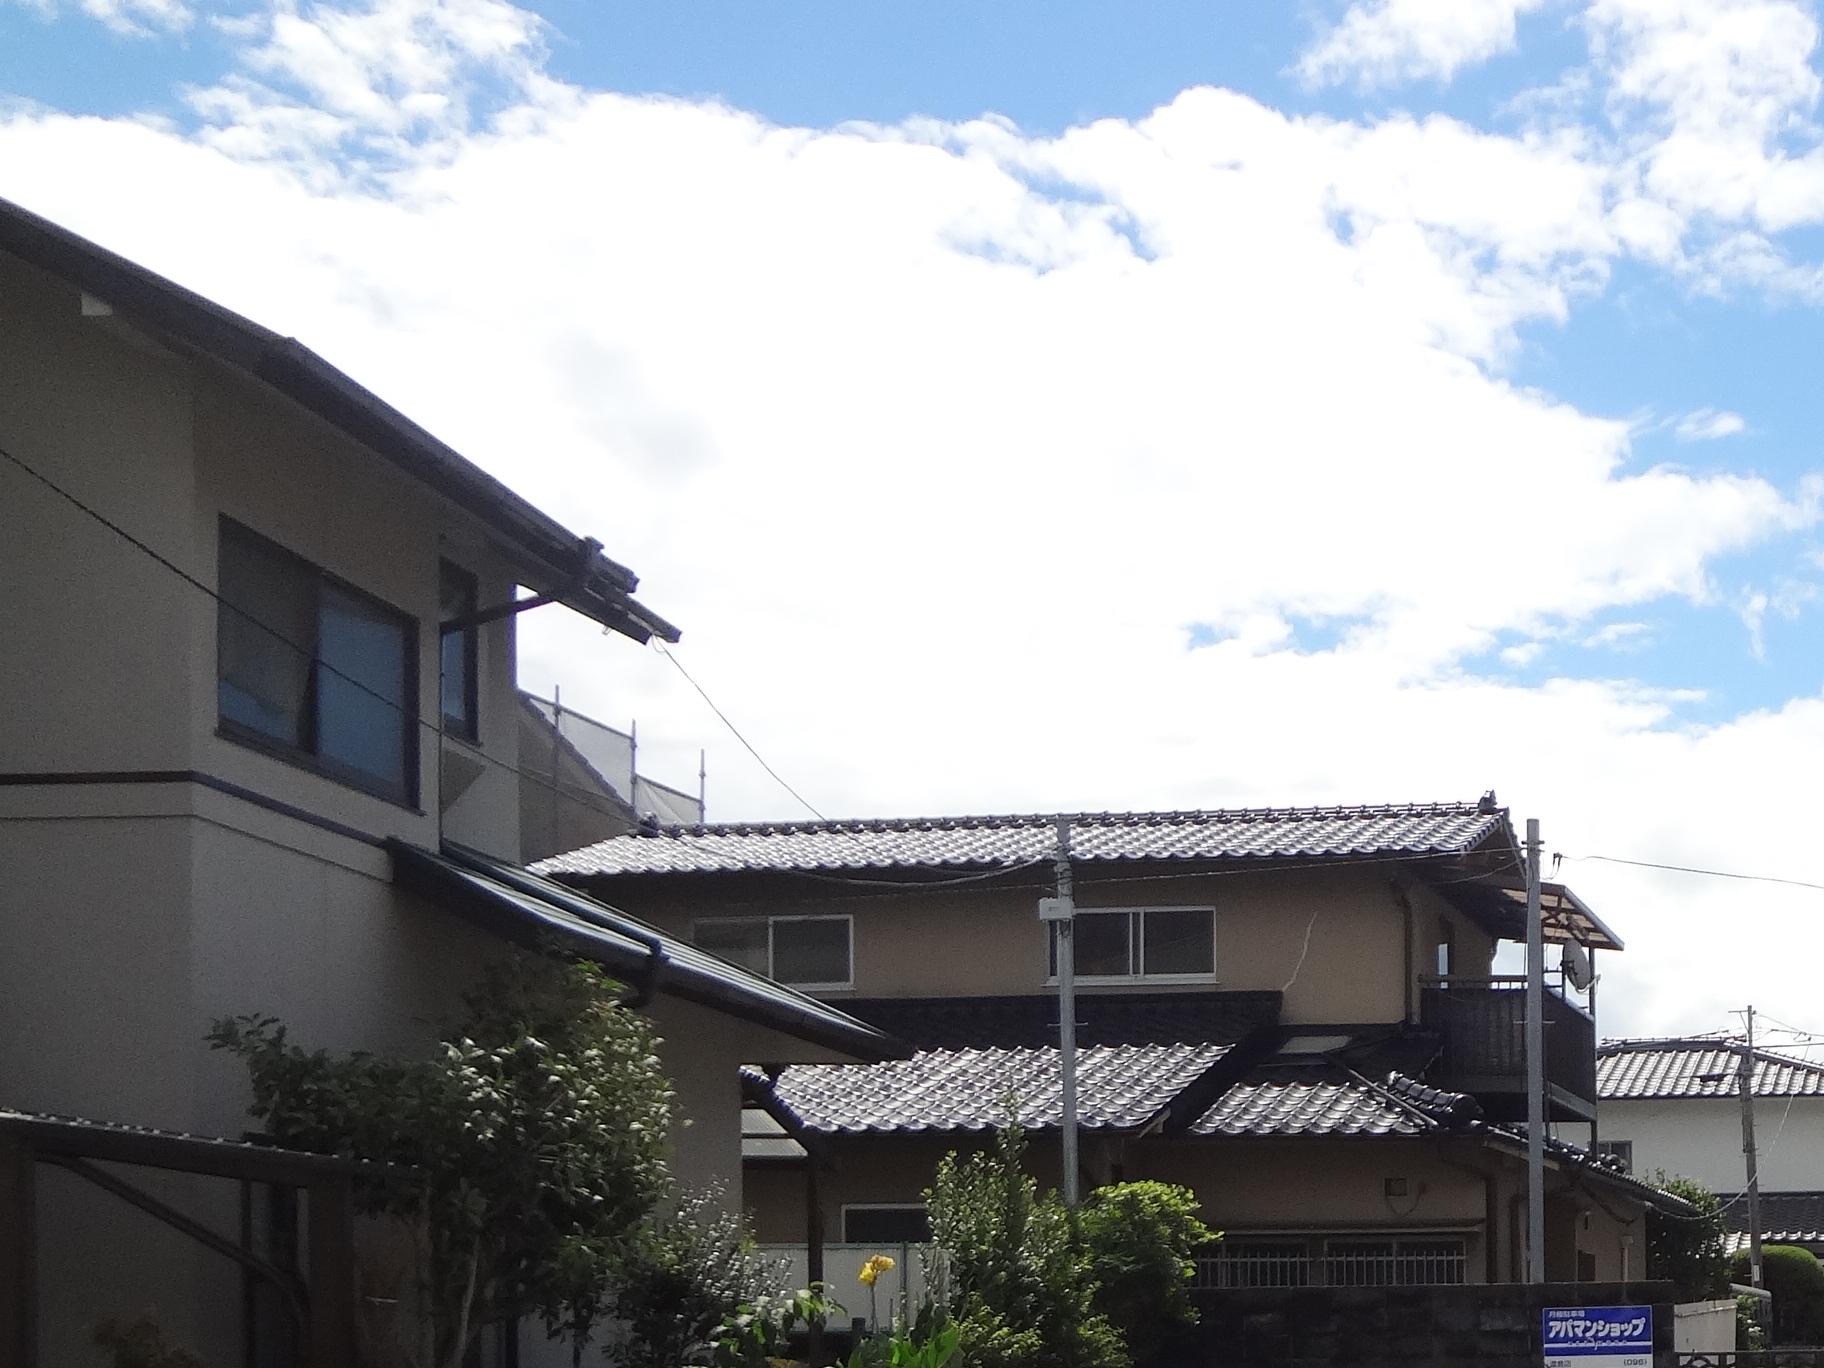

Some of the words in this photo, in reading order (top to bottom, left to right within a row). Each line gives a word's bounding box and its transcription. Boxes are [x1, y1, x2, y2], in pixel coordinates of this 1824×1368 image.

[1548, 1317, 1646, 1338] アパマンショップ
